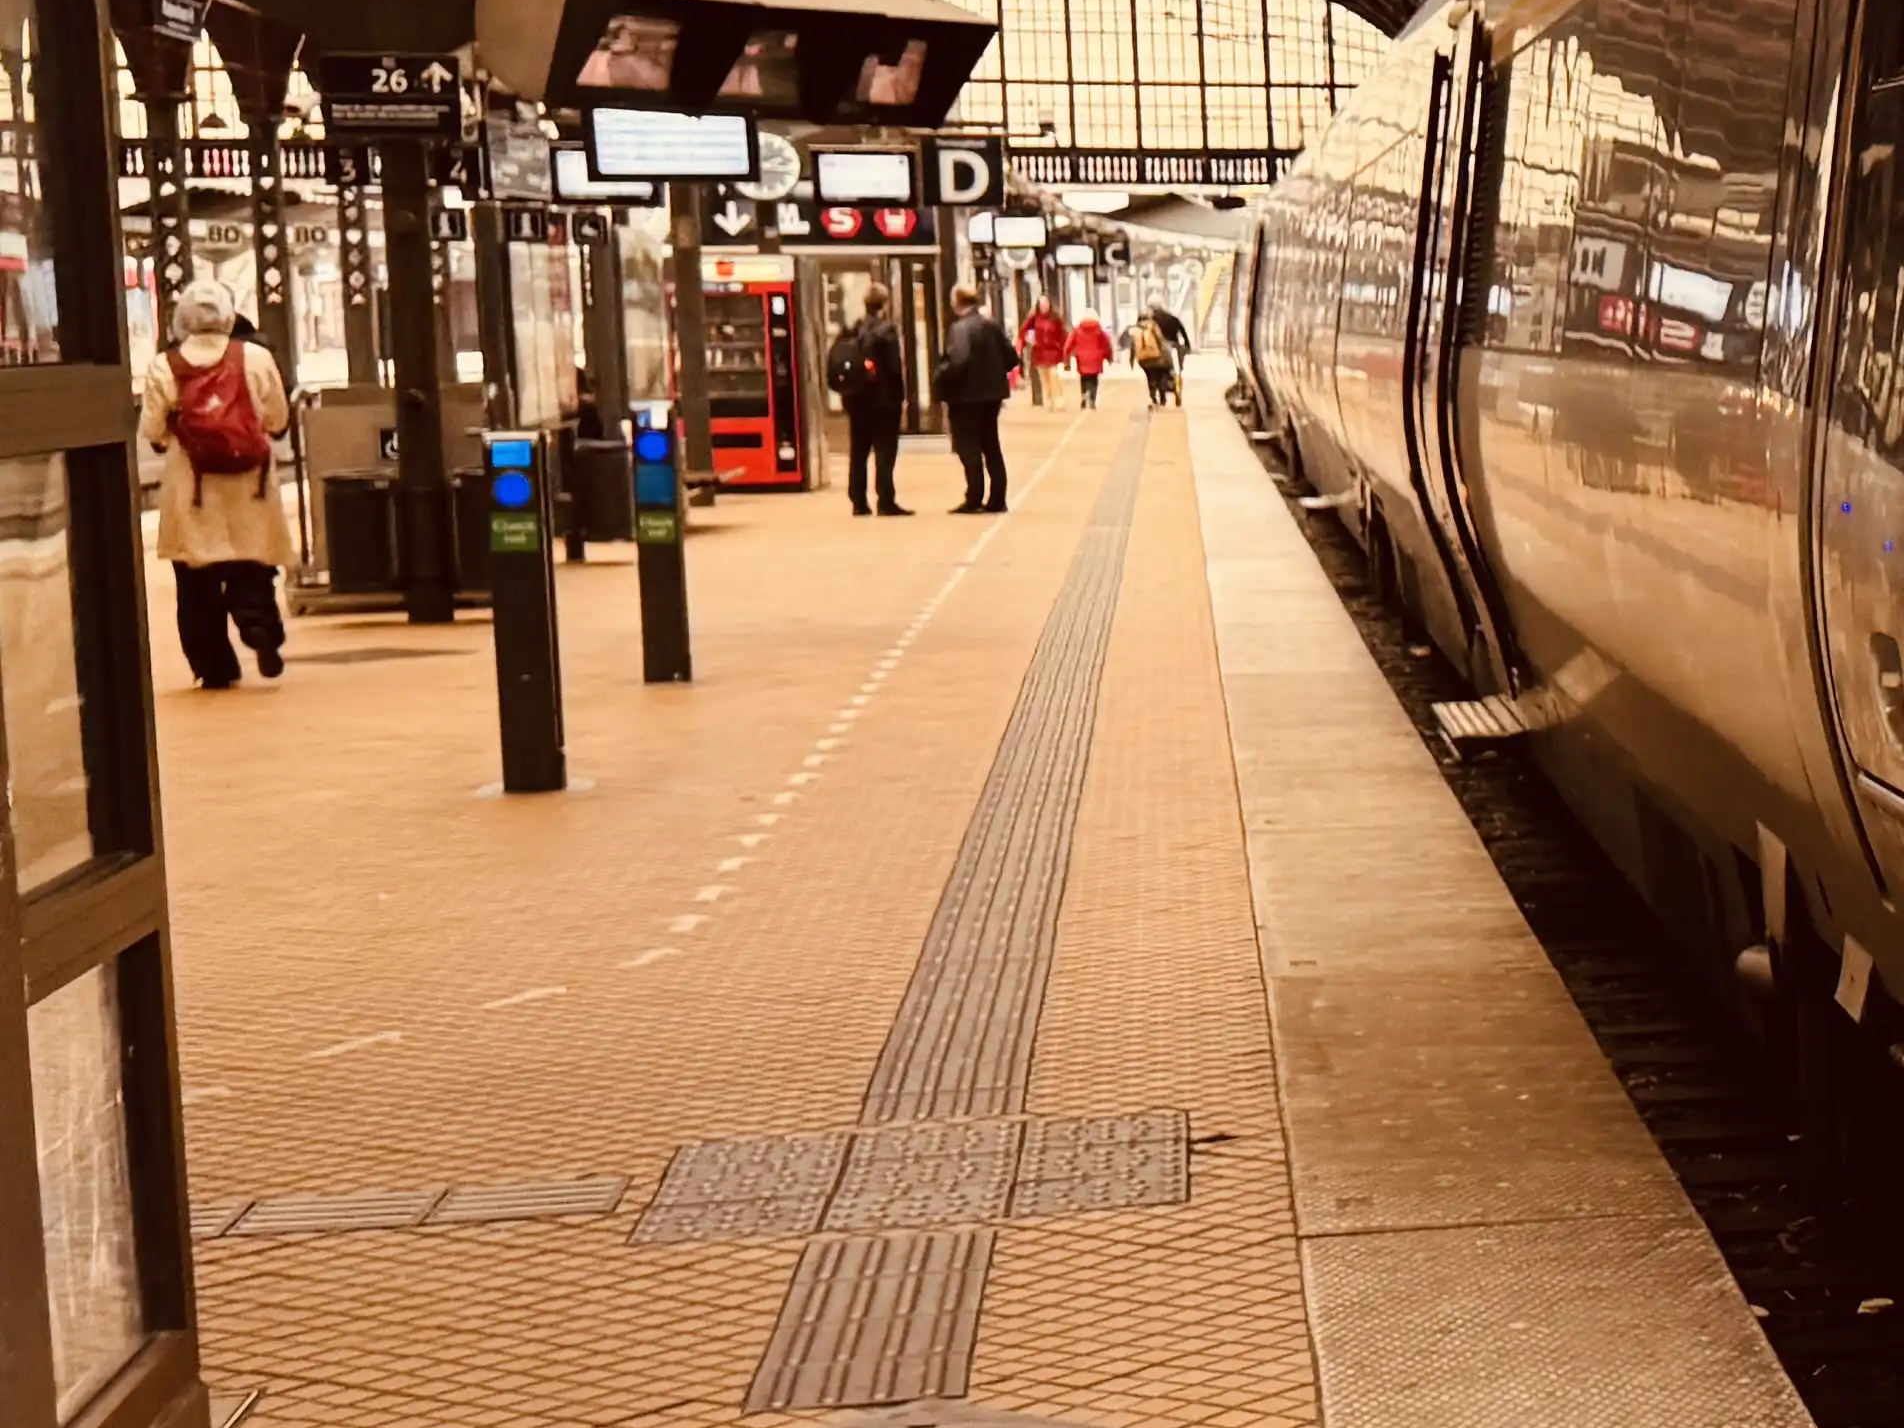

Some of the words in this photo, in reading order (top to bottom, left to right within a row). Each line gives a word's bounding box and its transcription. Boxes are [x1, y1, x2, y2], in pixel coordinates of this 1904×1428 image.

[371, 68, 409, 93] 26
[938, 148, 990, 203] D
[1104, 241, 1126, 267] C
